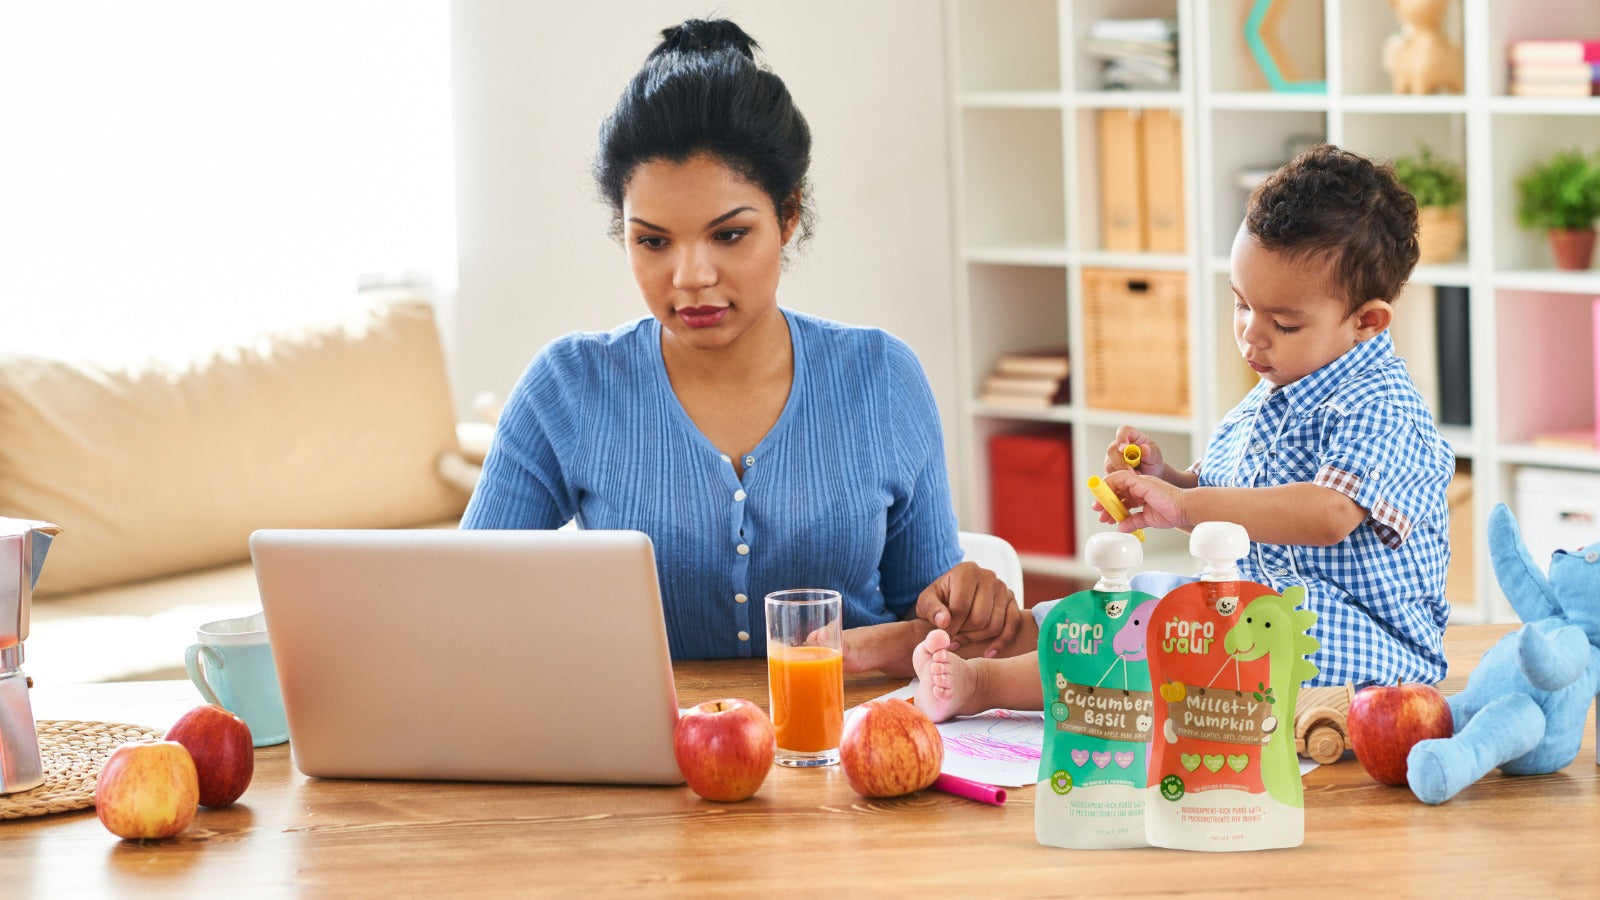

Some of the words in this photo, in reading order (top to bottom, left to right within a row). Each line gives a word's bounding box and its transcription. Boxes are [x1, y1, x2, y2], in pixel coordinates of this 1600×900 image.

[1064, 689, 1152, 712] Cucumber
[1084, 709, 1126, 728] Basil
[1184, 711, 1255, 732] Pumpkin
